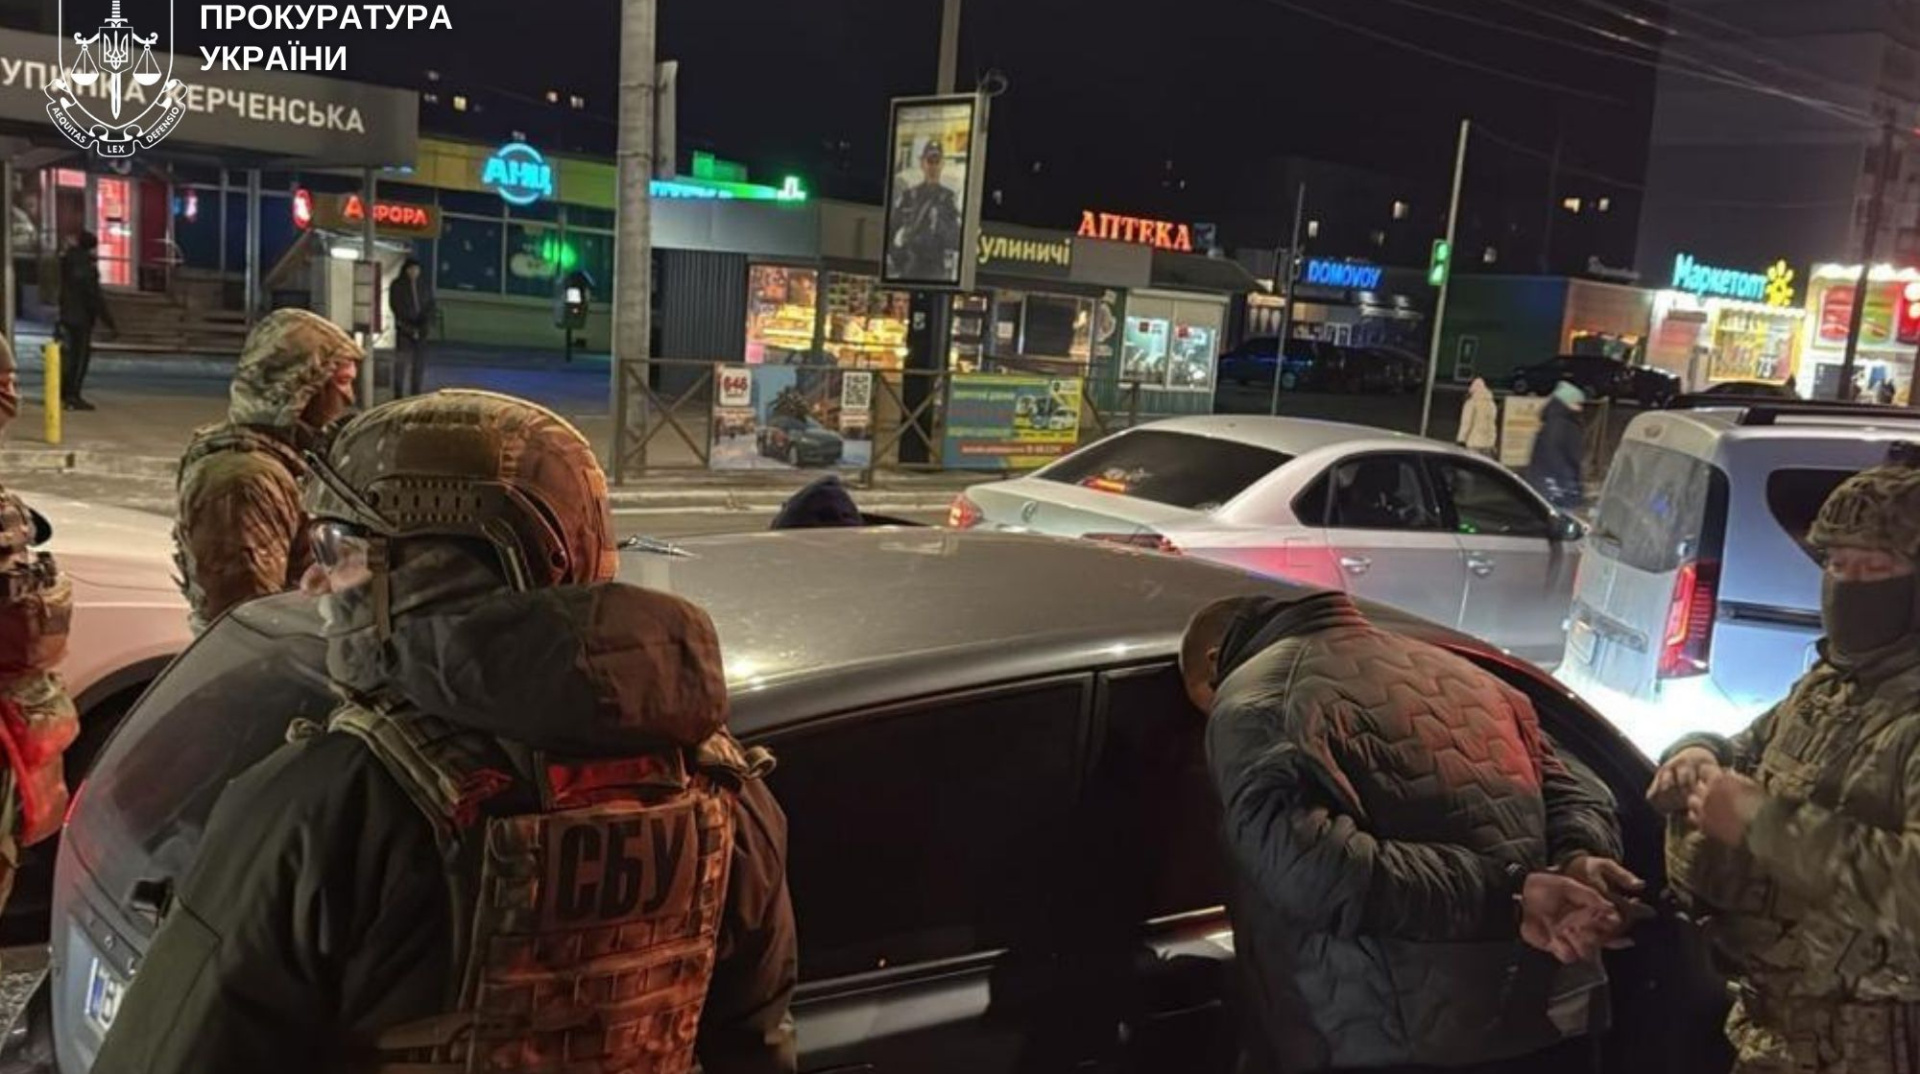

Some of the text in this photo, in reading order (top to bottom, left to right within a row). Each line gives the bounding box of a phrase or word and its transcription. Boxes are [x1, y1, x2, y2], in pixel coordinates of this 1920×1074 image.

[482, 157, 553, 195] АНЦ
[344, 195, 427, 225] АРОРА
[1077, 210, 1193, 251] АПТЕКА
[977, 235, 1071, 266] улиничі
[1308, 259, 1382, 288] DOMOVOY
[557, 814, 688, 922] СБУ
